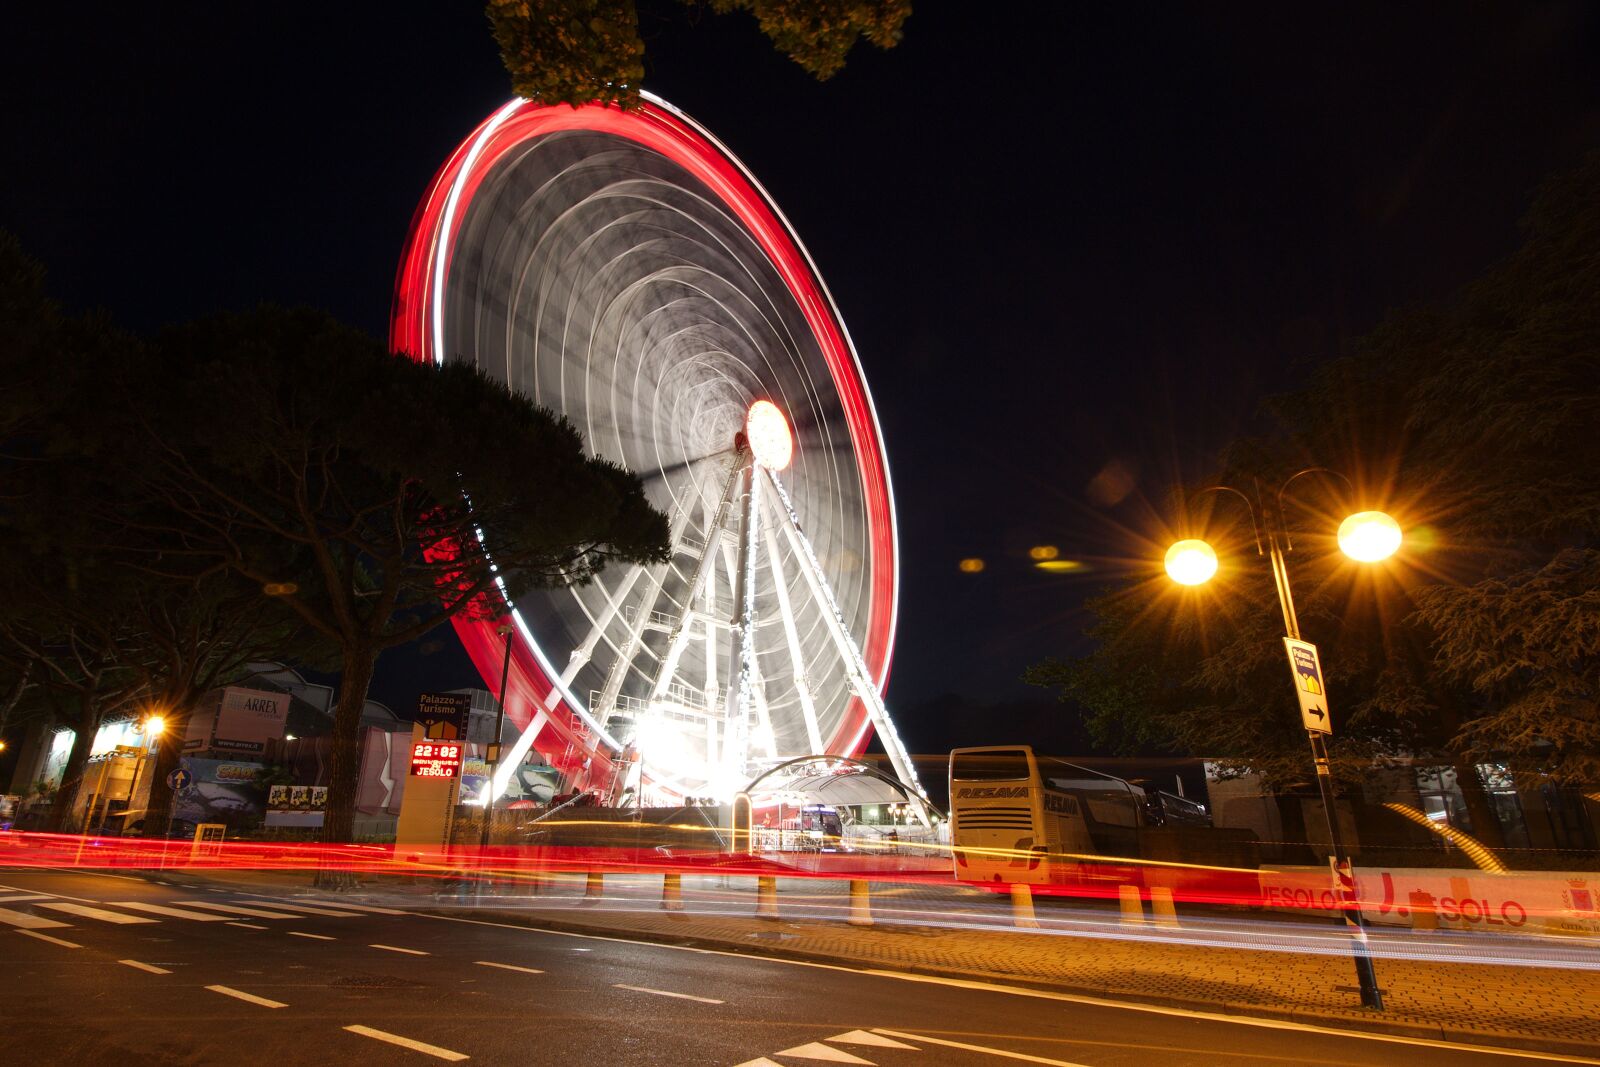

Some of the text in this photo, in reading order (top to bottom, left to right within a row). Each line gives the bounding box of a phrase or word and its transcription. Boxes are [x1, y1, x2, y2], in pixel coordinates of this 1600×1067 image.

[243, 697, 279, 714] ARREX
[421, 694, 455, 705] Palazzo
[419, 704, 456, 714] Turismo
[414, 745, 458, 758] 22:02
[416, 767, 453, 777] JESOLO
[957, 786, 1029, 799] RESAVA
[1043, 793, 1079, 816] RESAVA
[1263, 886, 1336, 910] JESOLO
[1432, 895, 1528, 928] SOLO
